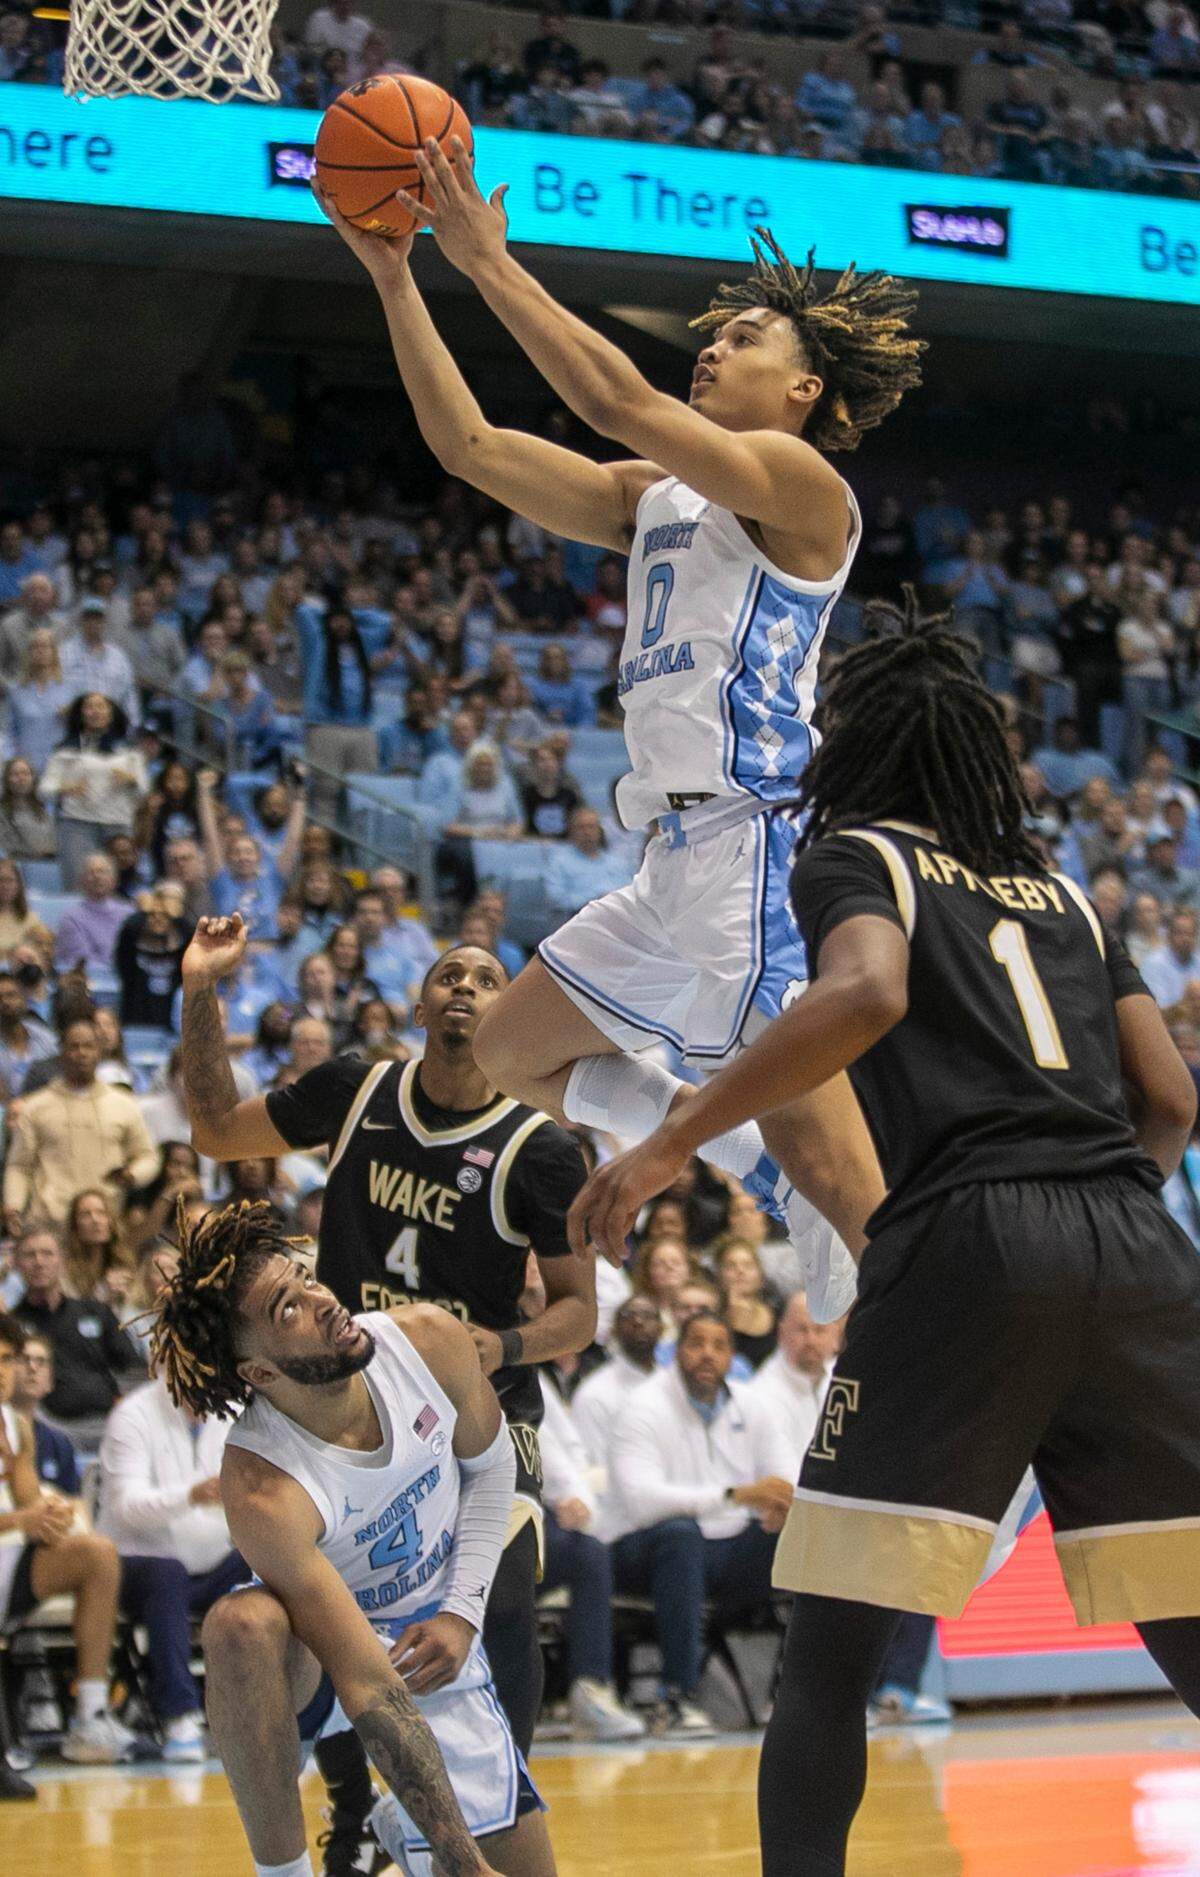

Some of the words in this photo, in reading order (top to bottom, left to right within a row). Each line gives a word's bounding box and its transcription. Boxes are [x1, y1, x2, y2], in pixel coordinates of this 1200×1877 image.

[535, 162, 599, 216] Be
[622, 173, 770, 228] There
[1141, 225, 1198, 276] Be
[640, 562, 675, 650] 0
[988, 917, 1070, 1070] 1
[369, 1160, 463, 1233] WAKE
[385, 1227, 420, 1290] 4
[354, 1464, 441, 1546] NORTH
[368, 1508, 423, 1577] 4
